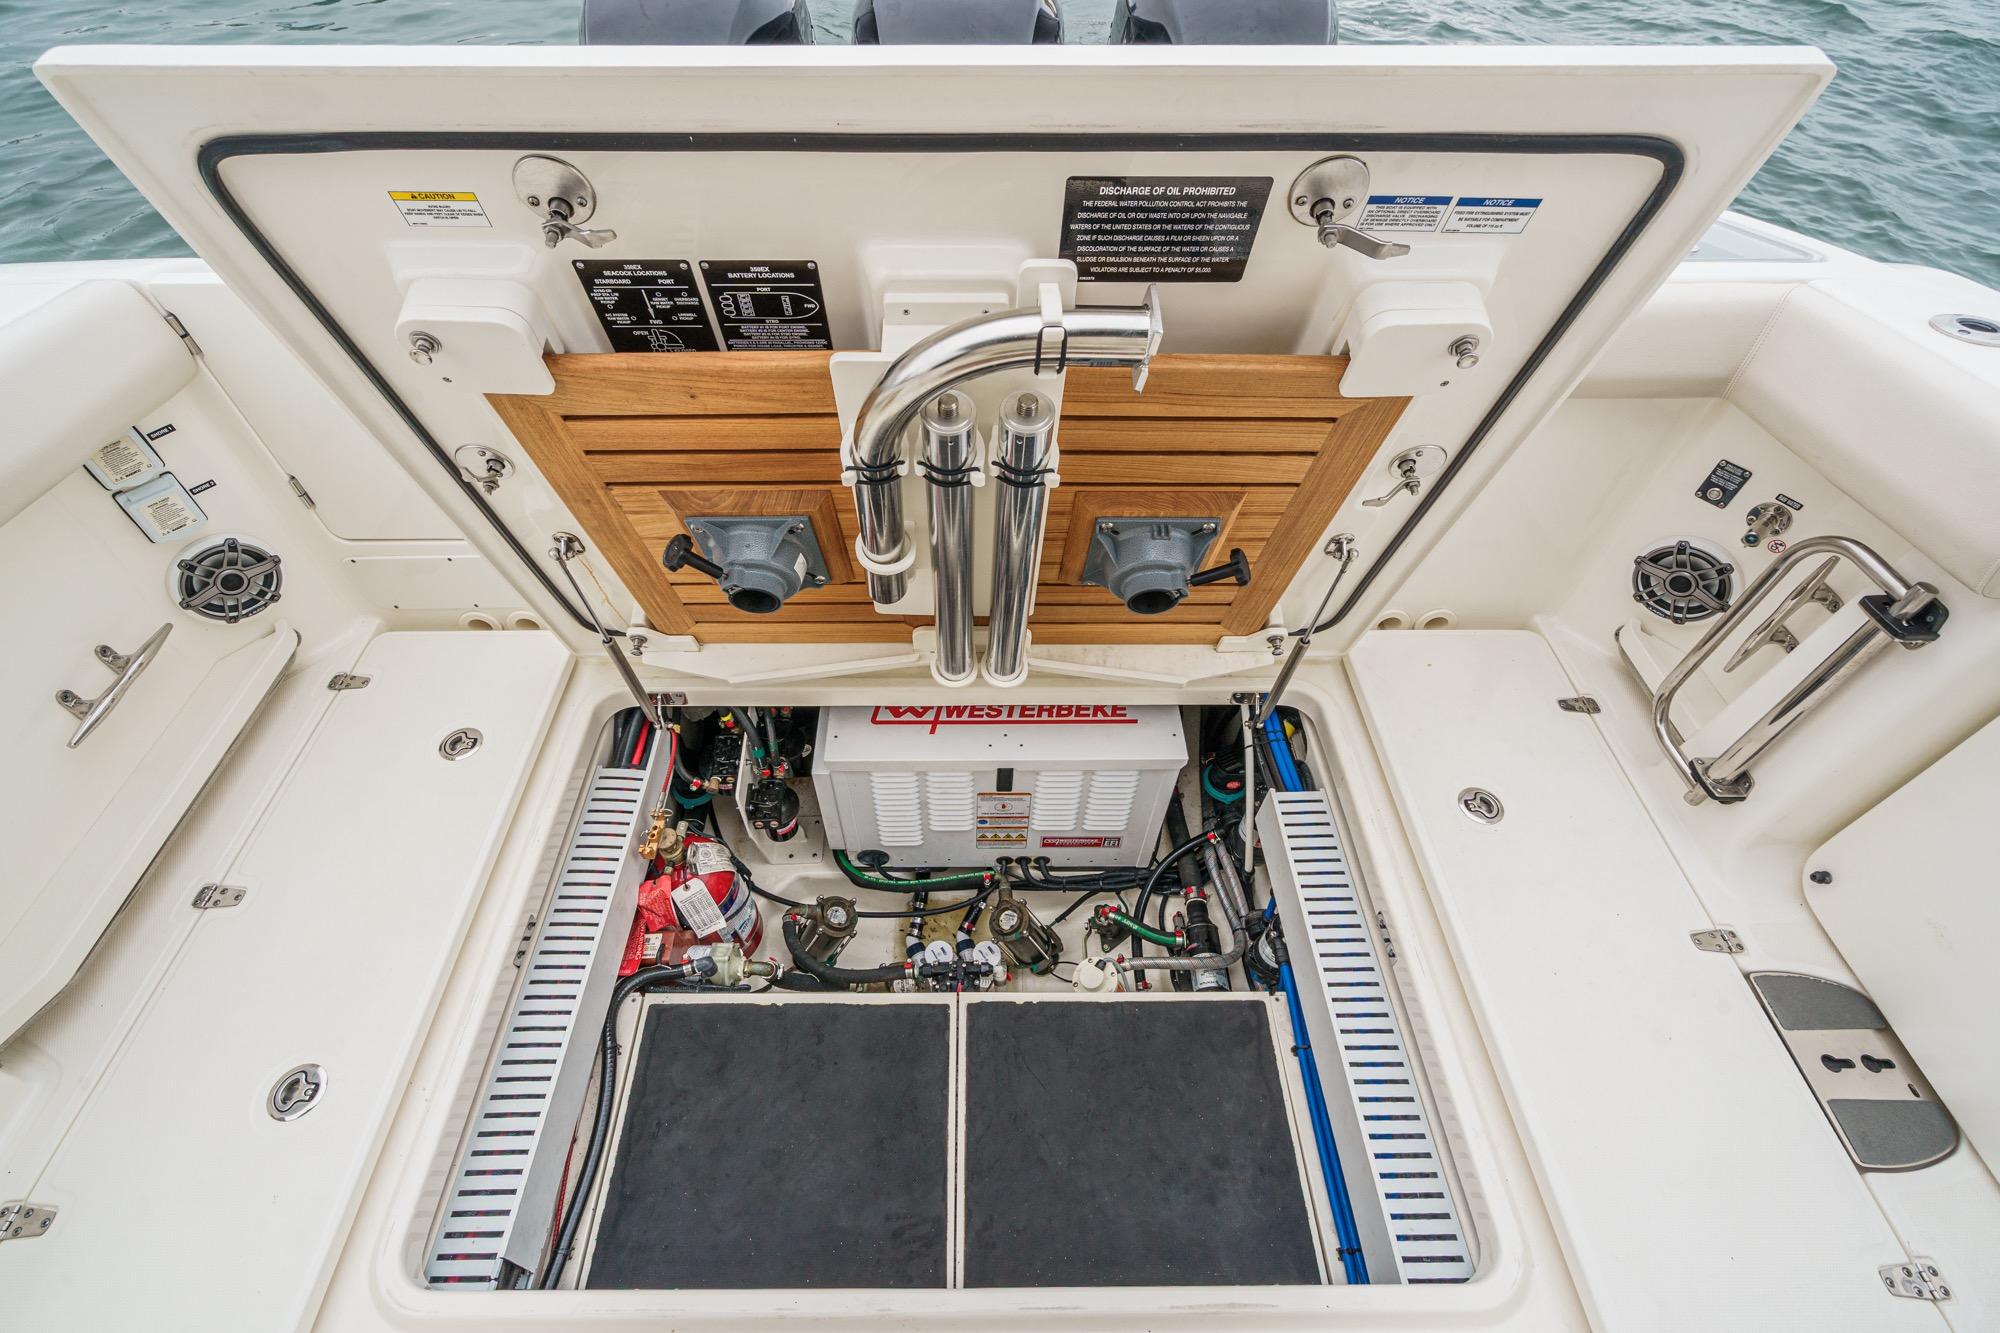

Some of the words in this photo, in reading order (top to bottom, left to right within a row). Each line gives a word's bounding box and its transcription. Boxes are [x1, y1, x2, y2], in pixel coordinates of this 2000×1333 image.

[1100, 186, 1151, 195] DISCHARGE
[1153, 186, 1165, 195] OF
[1167, 186, 1180, 195] OIL
[1183, 186, 1236, 195] PROHIBITED
[150, 427, 169, 439] SHORE
[192, 482, 210, 494] SHORE
[945, 705, 1128, 719] WESTERBEKE
